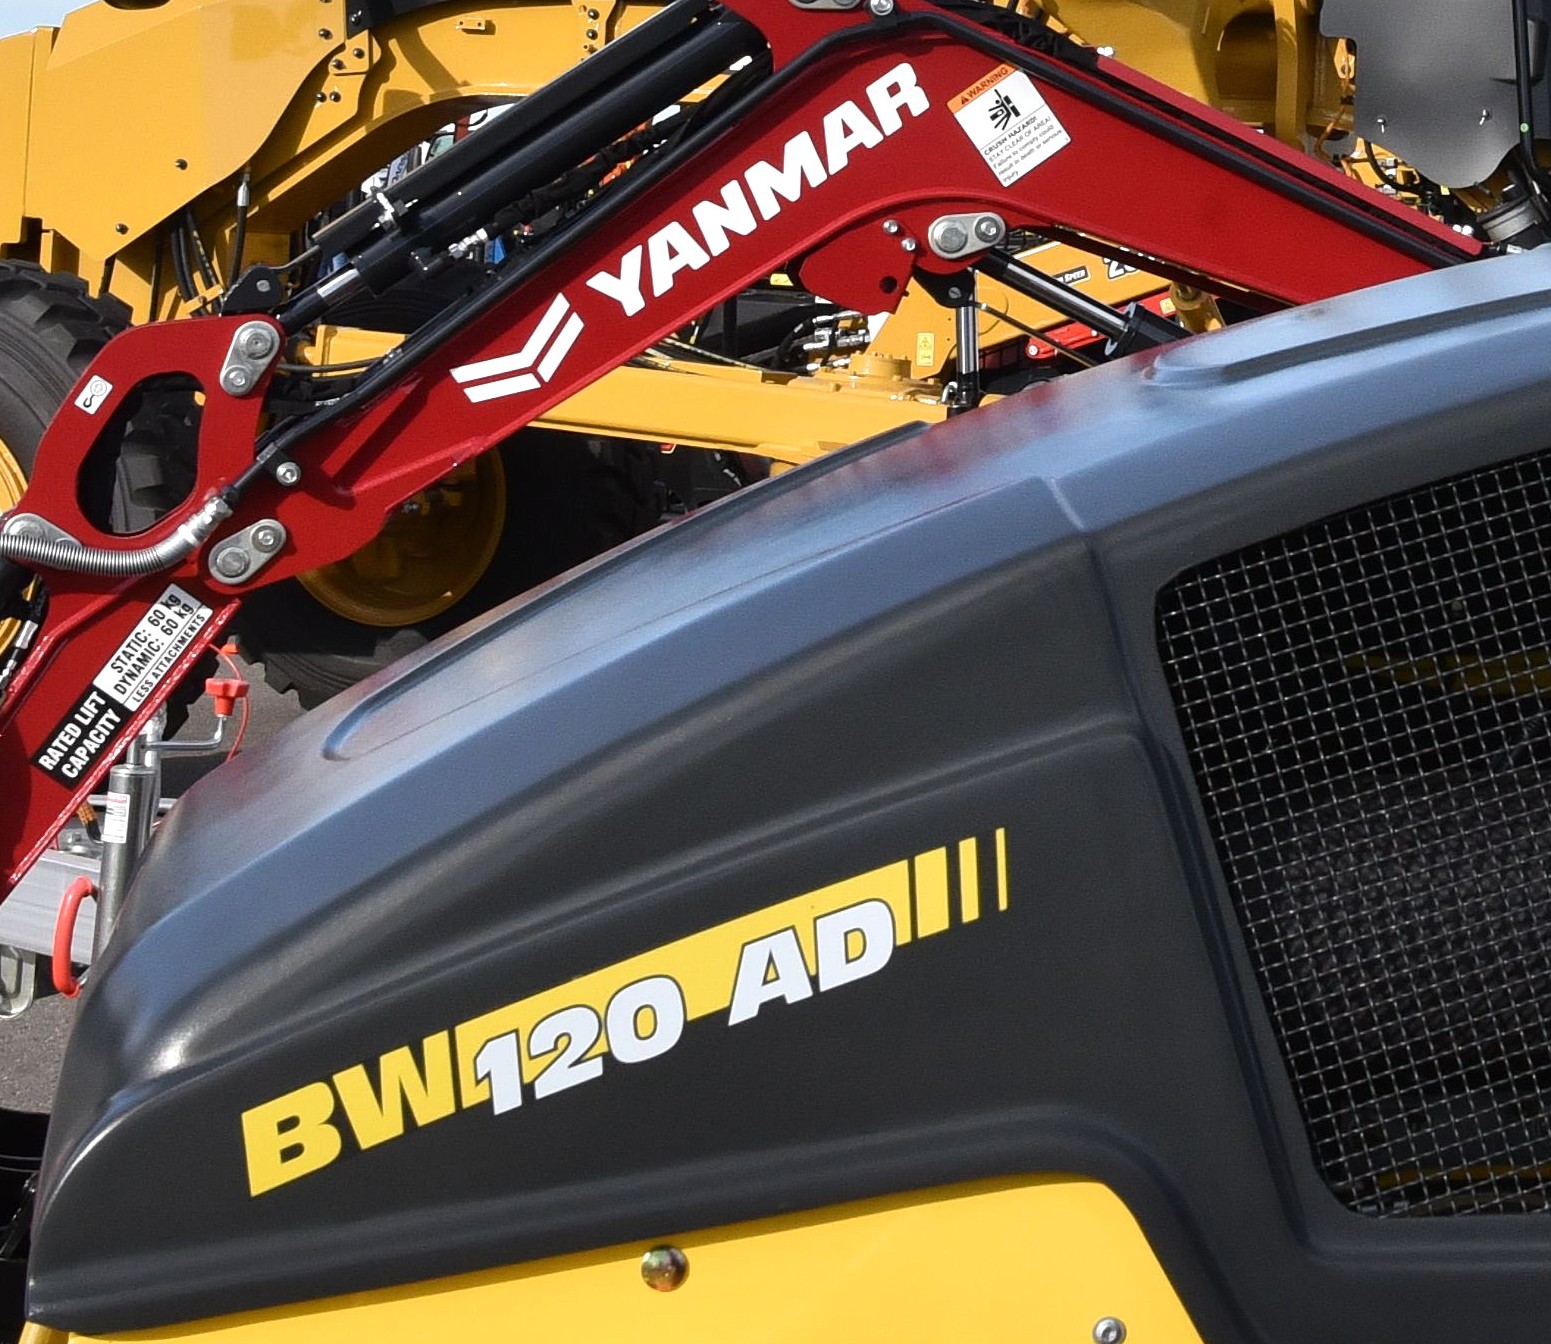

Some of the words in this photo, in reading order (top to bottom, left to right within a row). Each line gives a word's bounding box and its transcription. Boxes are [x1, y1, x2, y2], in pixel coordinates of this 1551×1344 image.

[966, 66, 1009, 97] WARNING
[586, 62, 930, 317] YANMAR
[110, 628, 151, 674] STATIC:
[147, 609, 166, 628] 60
[160, 593, 182, 611] kg
[113, 637, 165, 696] DYNAMIC:
[160, 617, 179, 636] 60
[173, 602, 195, 619] kg
[132, 679, 154, 703] LESS
[152, 614, 206, 679] ATTACHMENTS
[38, 722, 82, 771] RATED
[74, 690, 107, 727] LIFT
[61, 707, 121, 778] CAPACITY
[727, 897, 897, 1027] AD
